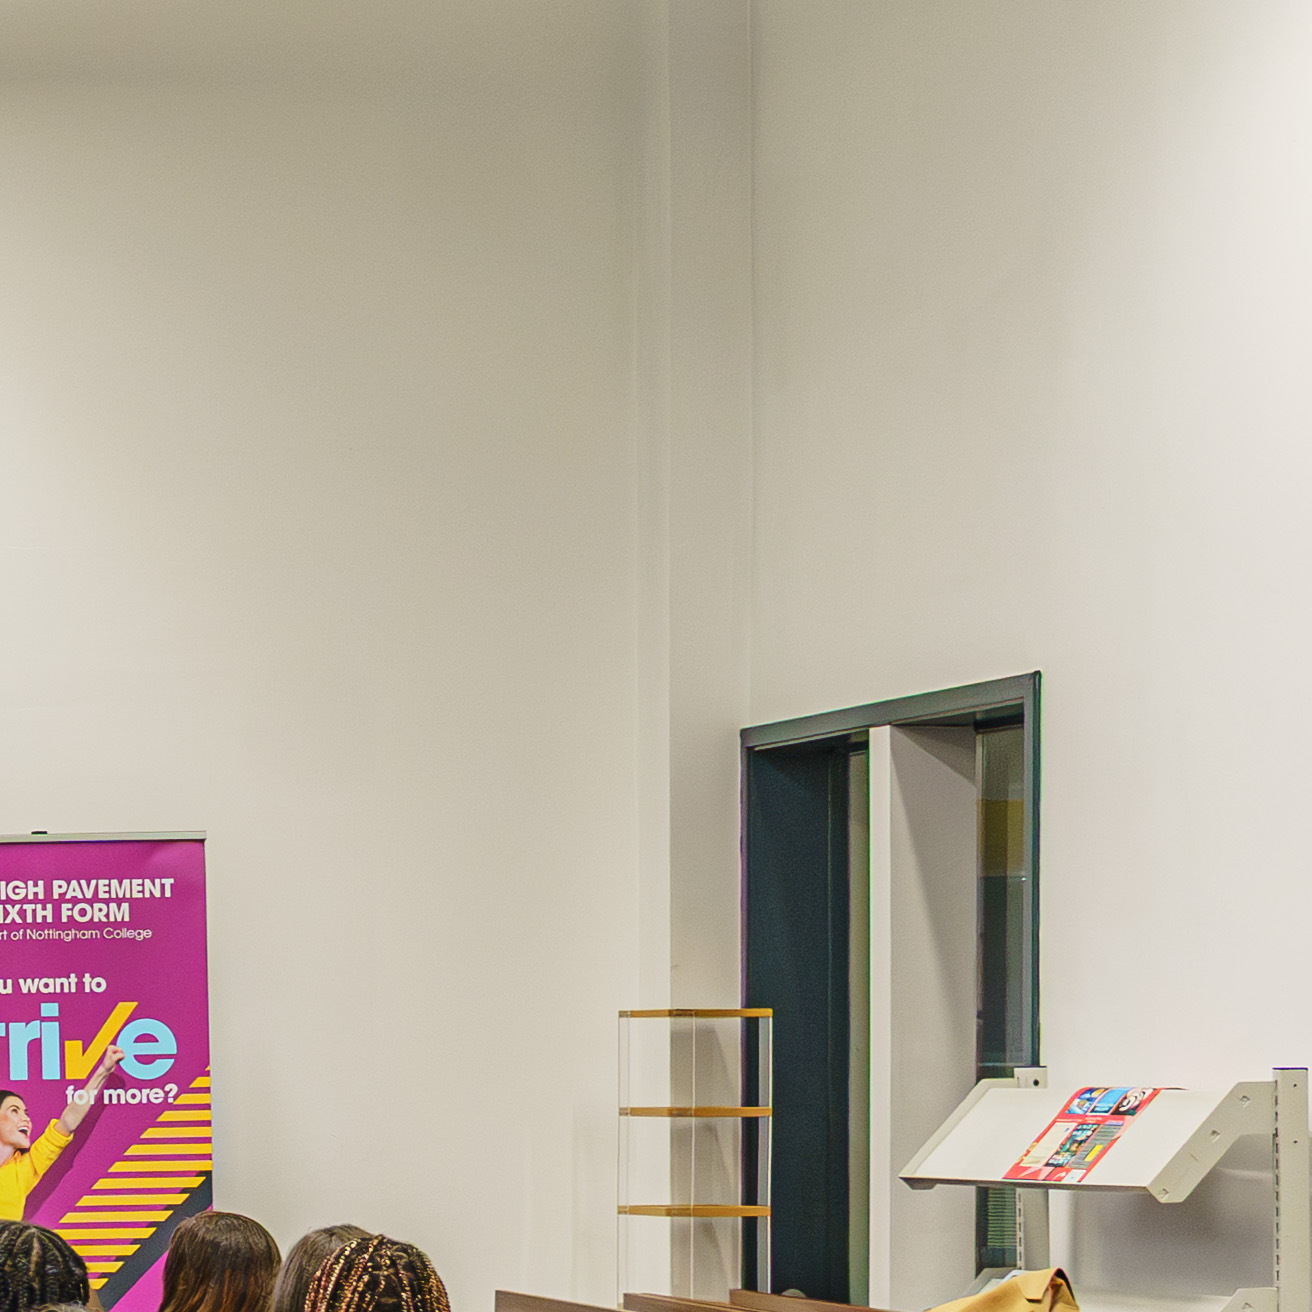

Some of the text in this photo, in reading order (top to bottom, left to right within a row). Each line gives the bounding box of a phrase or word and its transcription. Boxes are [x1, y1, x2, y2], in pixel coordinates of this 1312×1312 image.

[52, 877, 175, 900] PAVEMENT
[61, 902, 130, 923] FORM
[10, 928, 25, 941] of
[26, 928, 101, 943] Nottingham
[102, 927, 153, 942] College
[18, 972, 78, 994] want
[82, 972, 107, 993] to
[65, 1083, 178, 1106] for more?
